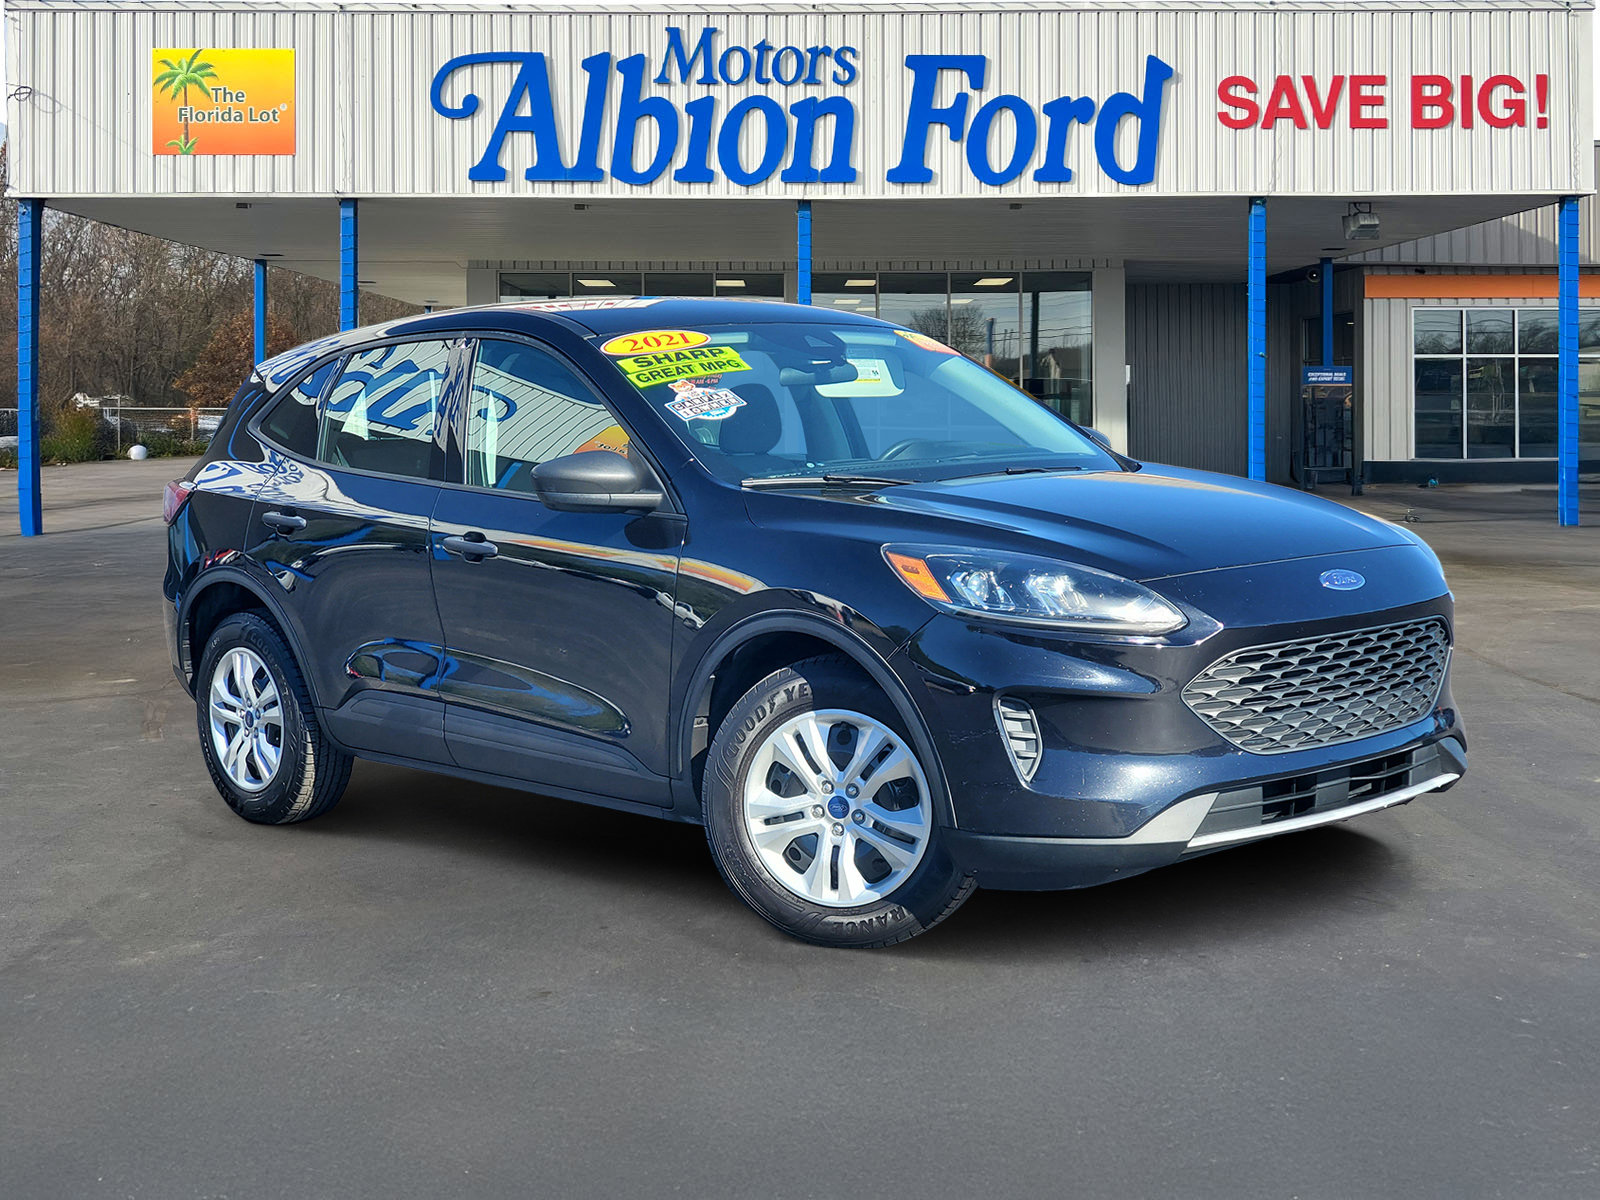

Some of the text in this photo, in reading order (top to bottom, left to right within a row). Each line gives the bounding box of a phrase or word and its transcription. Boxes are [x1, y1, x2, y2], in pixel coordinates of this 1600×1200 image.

[652, 26, 858, 87] Motors
[211, 86, 246, 103] The
[1217, 74, 1549, 130] SAVE BIG!
[178, 106, 244, 123] Florida
[430, 51, 1177, 187] Albion Ford
[622, 333, 691, 352] 2021
[632, 348, 725, 369] SHARP
[635, 359, 740, 384] GREAT MPG
